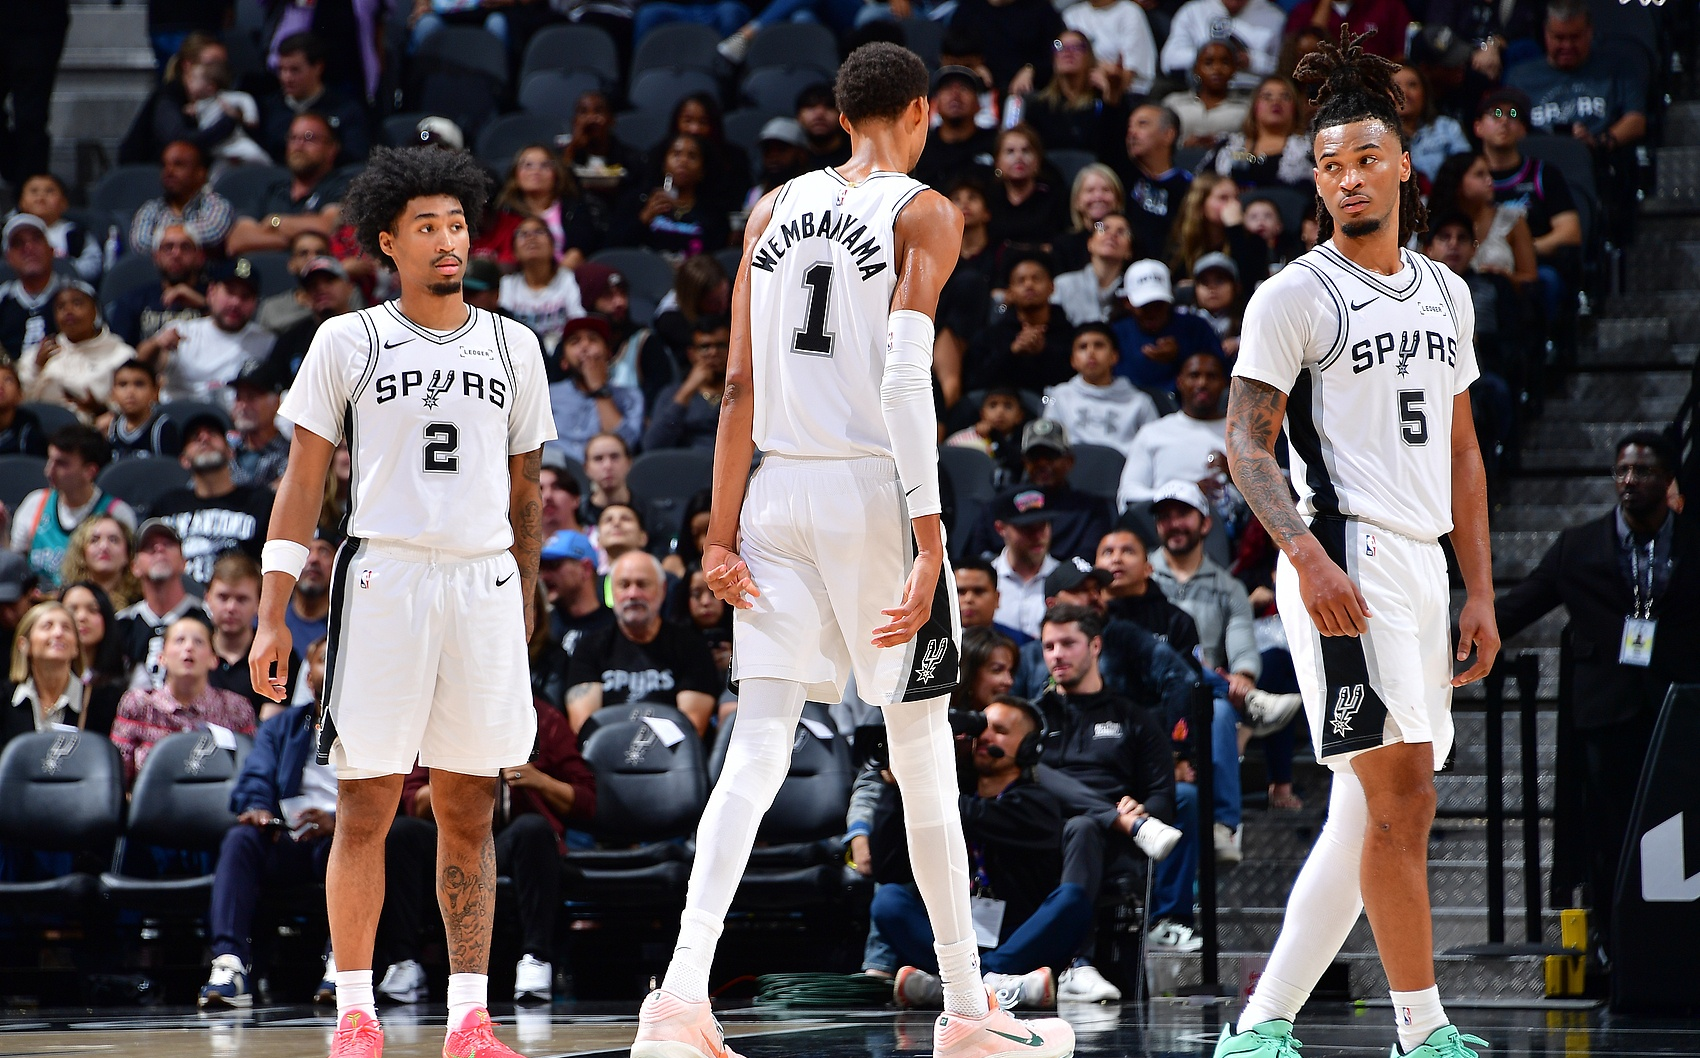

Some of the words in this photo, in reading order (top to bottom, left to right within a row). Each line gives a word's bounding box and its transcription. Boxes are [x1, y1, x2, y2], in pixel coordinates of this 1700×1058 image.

[790, 260, 836, 358] 1
[1351, 330, 1457, 379] SPURS
[376, 369, 506, 410] SPURS
[1397, 388, 1430, 447] 5
[422, 421, 460, 474] 2
[601, 669, 675, 704] SPURS
